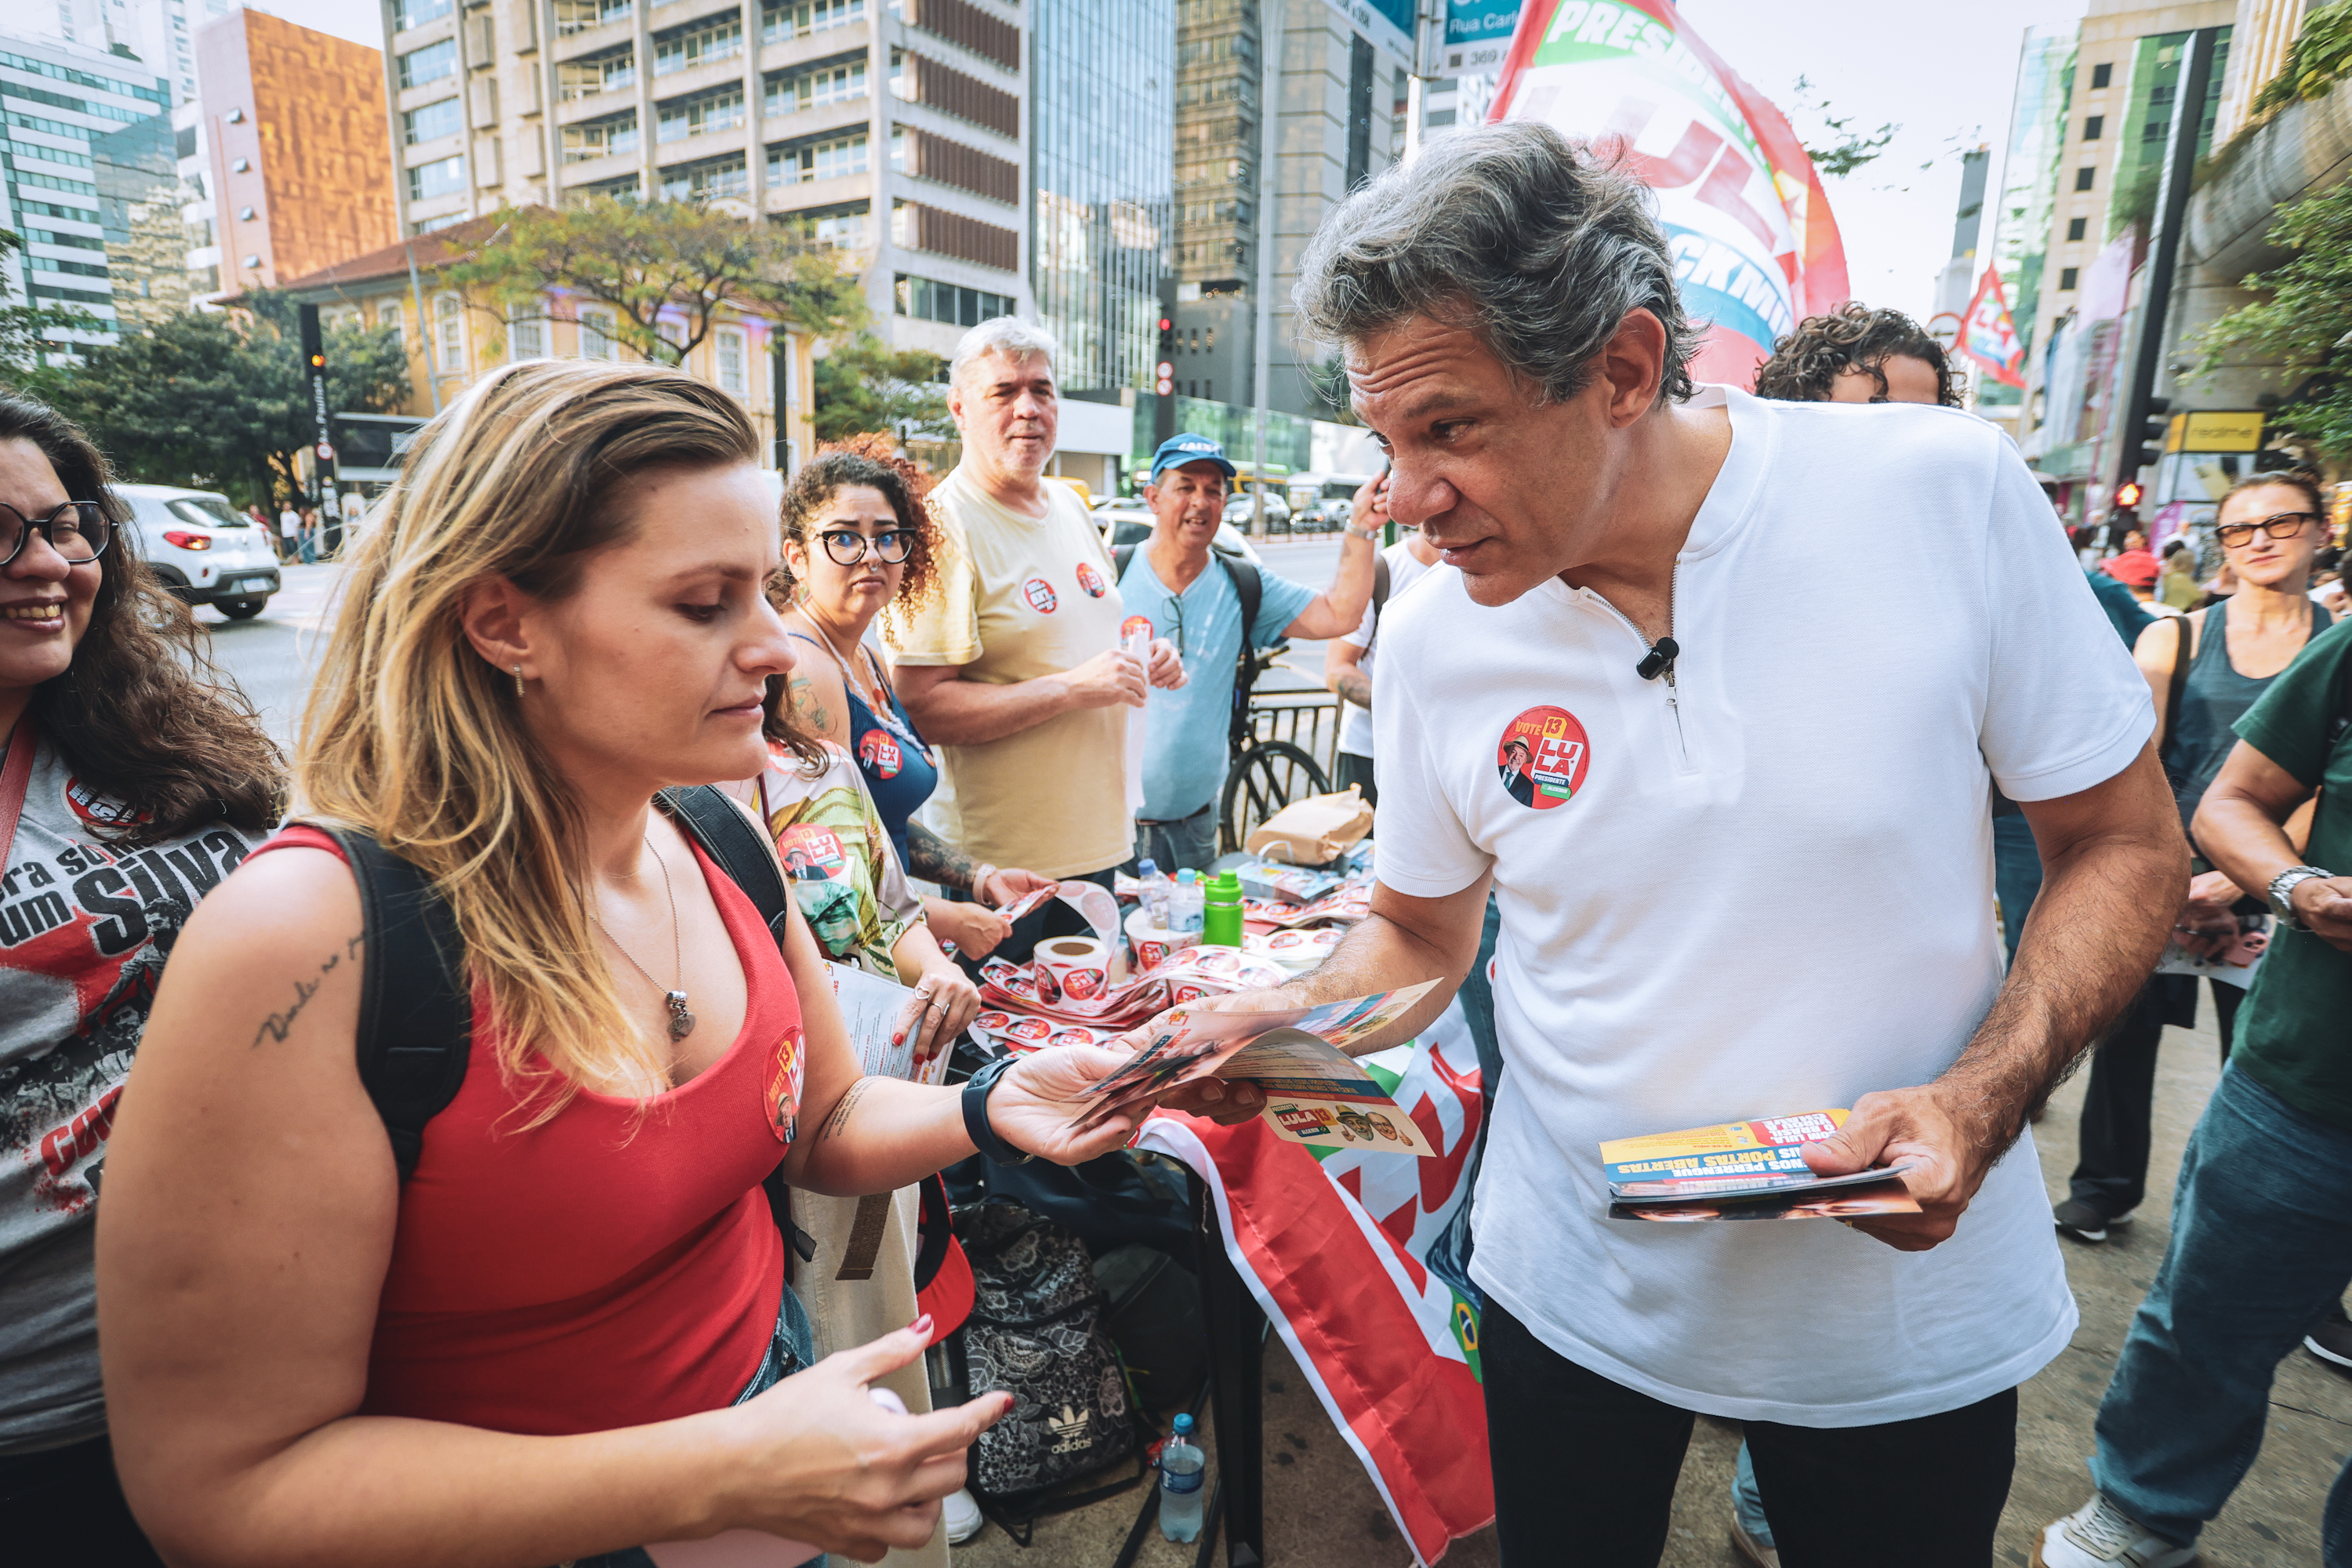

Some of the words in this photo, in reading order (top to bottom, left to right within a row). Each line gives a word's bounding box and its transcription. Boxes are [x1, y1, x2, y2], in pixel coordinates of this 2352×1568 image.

[1450, 17, 1480, 34] Rua
[1471, 50, 1497, 65] 369
[1669, 233, 1794, 337] CKMI
[1515, 720, 1543, 736] VOTE
[1545, 718, 1563, 734] 13
[1539, 739, 1578, 759] LU
[1534, 755, 1570, 776] LA
[1534, 774, 1566, 786] PRESIDENTE
[800, 829, 812, 839] 13
[0, 862, 56, 900] ra
[72, 831, 252, 955] Silva
[768, 1068, 786, 1103] VOTE
[779, 1044, 790, 1067] 13
[1278, 1111, 1317, 1126] LULA
[1315, 1109, 1331, 1122] 13
[1761, 1113, 1828, 1126] CHAVE
[1786, 1117, 1832, 1131] VIROU
[1769, 1125, 1825, 1138] BRASIL
[1769, 1134, 1805, 1145] LULA,
[1703, 1149, 1777, 1168] PORTAS
[1777, 1146, 1802, 1159] AIS
[1617, 1157, 1699, 1174] ABERTAS
[1671, 1162, 1766, 1178] PERRENGUE
[1051, 1437, 1093, 1455] adidas
